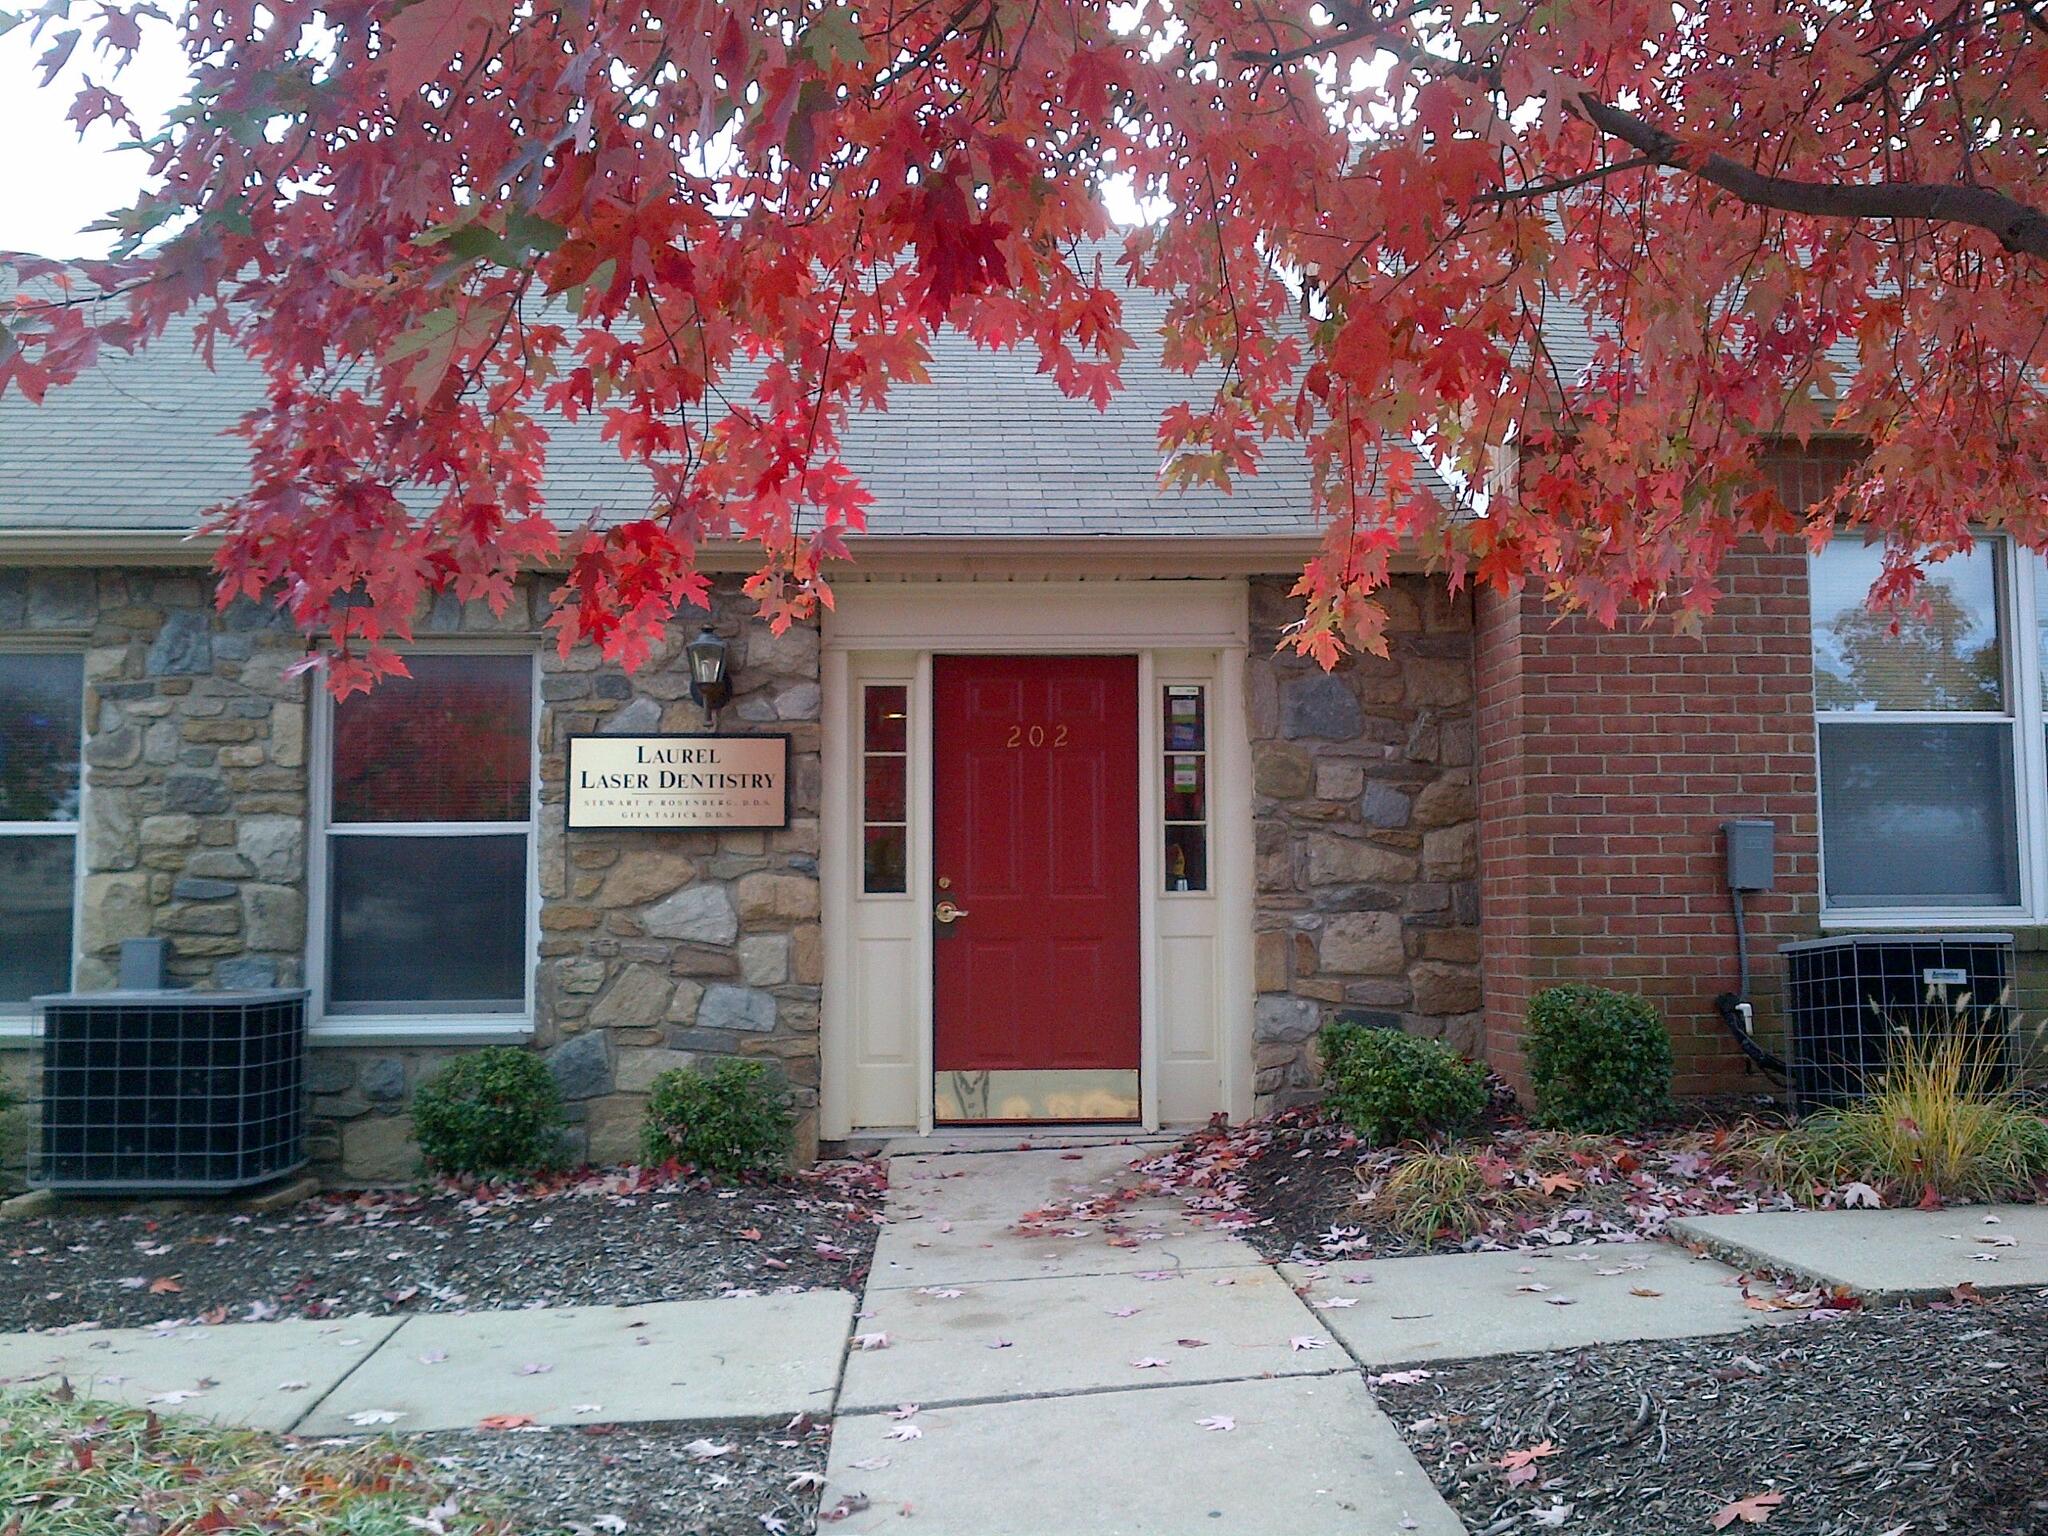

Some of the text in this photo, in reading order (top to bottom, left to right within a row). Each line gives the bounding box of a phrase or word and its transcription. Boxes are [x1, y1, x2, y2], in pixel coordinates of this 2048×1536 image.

[1007, 725, 1068, 748] 202
[636, 745, 722, 764] LAUREL
[580, 770, 777, 789] LASER DENTISTRY
